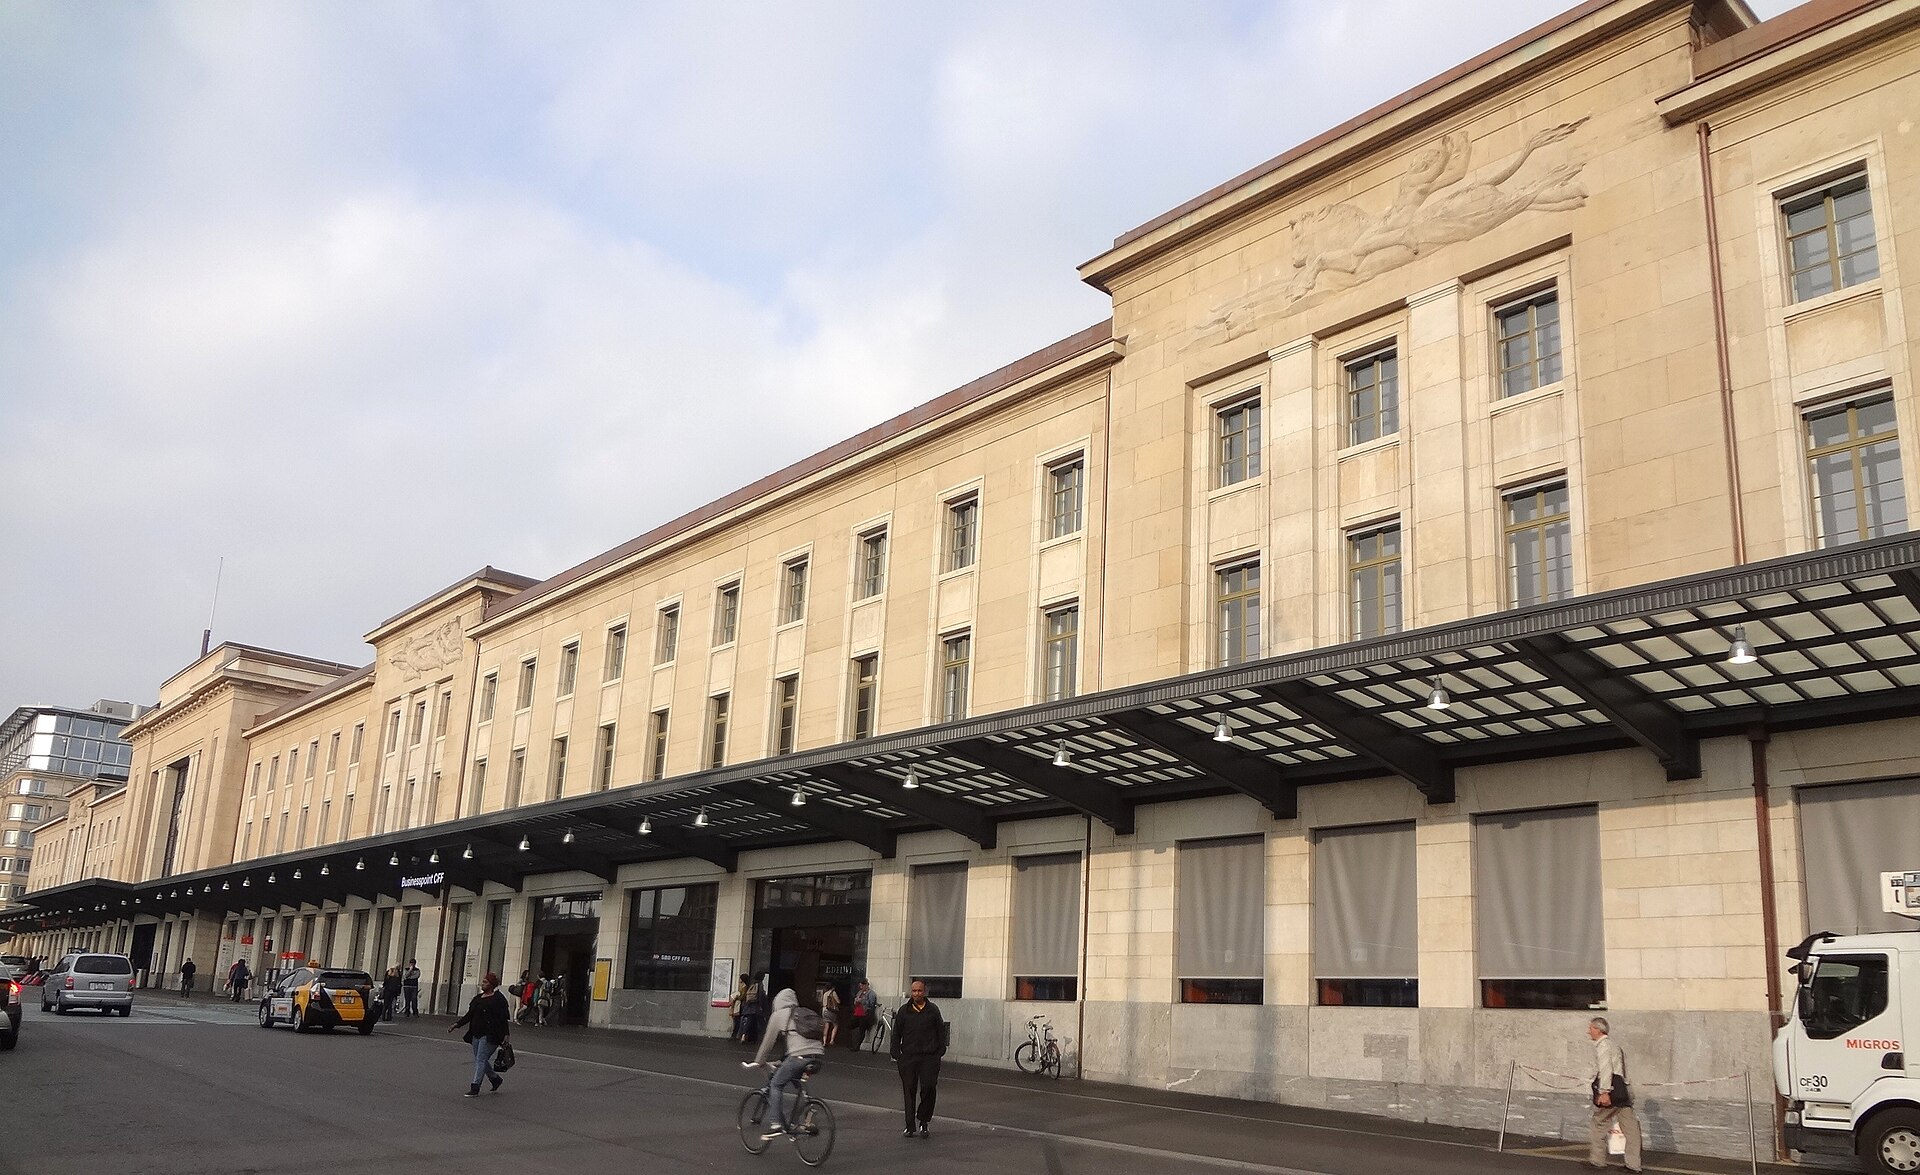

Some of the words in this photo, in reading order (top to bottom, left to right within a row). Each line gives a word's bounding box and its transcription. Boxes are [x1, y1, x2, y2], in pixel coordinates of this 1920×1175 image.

[401, 874, 434, 888] Businesspoint
[434, 872, 445, 884] CFF
[1846, 1039, 1900, 1050] MIGROS
